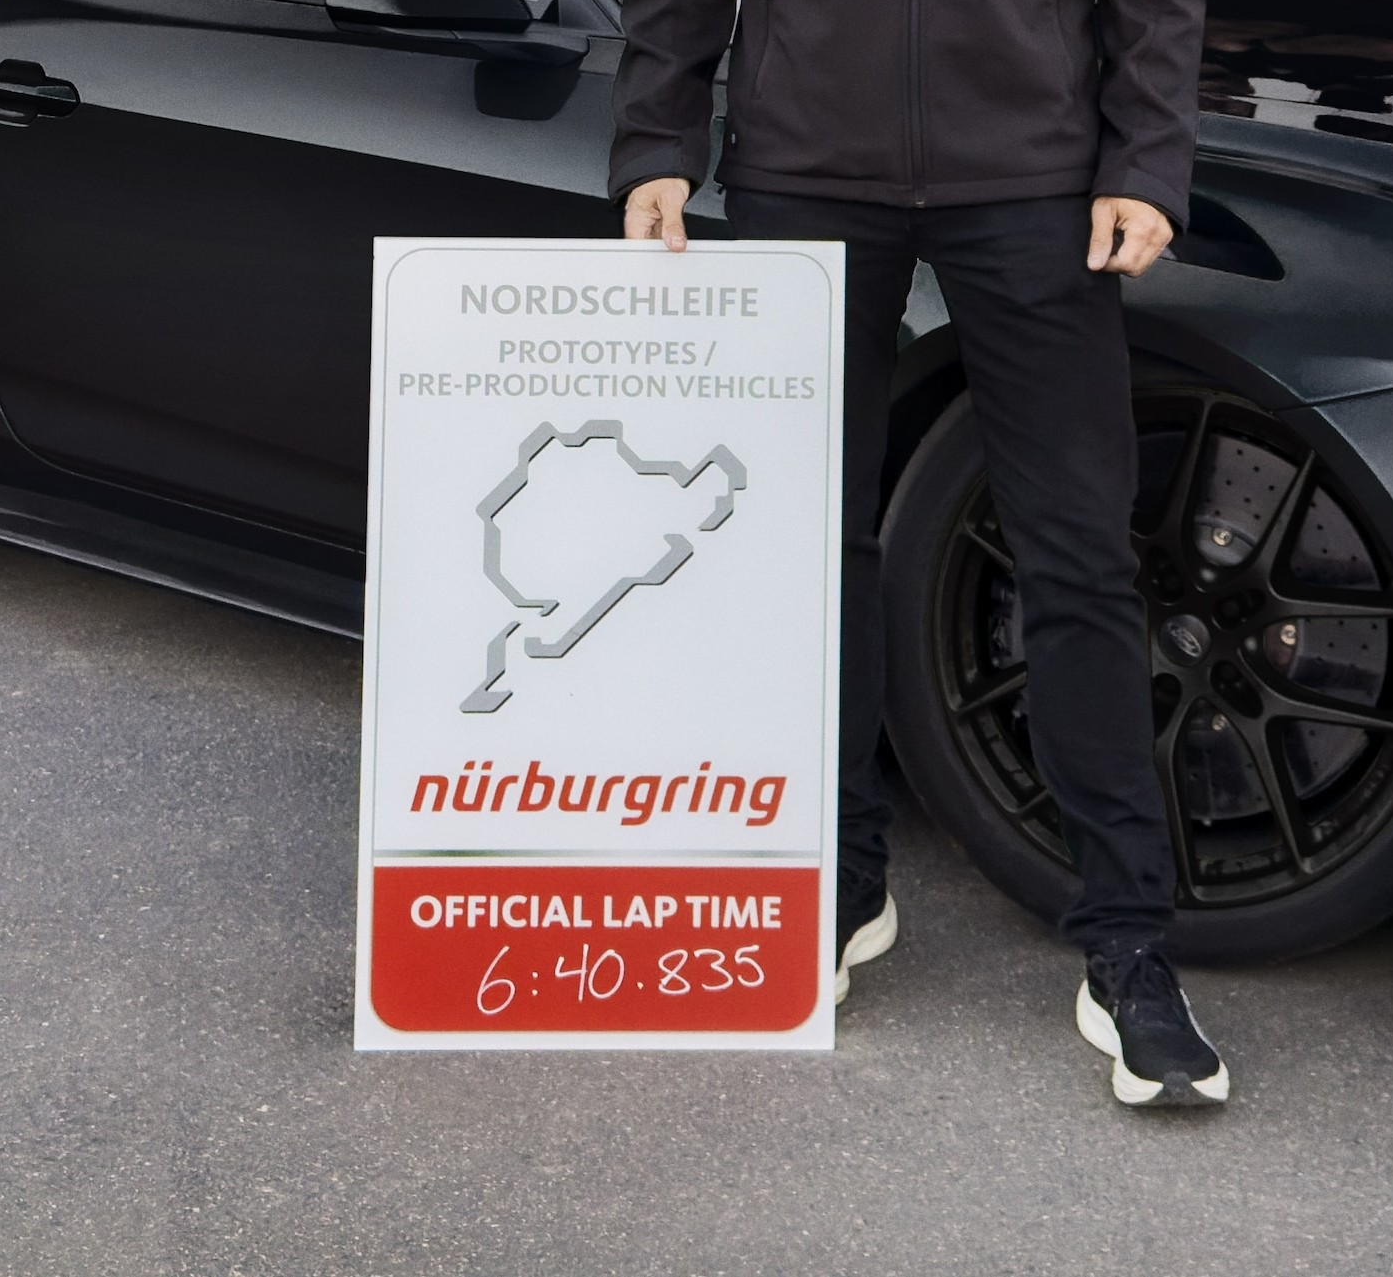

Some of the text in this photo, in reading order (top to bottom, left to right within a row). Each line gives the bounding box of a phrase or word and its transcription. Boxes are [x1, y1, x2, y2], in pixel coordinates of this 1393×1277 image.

[460, 284, 760, 318] NORDSCHLEIFE
[498, 340, 718, 369] PROTOTYPES /
[398, 374, 816, 401] PRE-PRODUCTION VEHICLES
[410, 760, 787, 828] nürburgring
[410, 894, 783, 930] OFFICIAL LAP TIME
[476, 943, 766, 1016] 6:40.835
